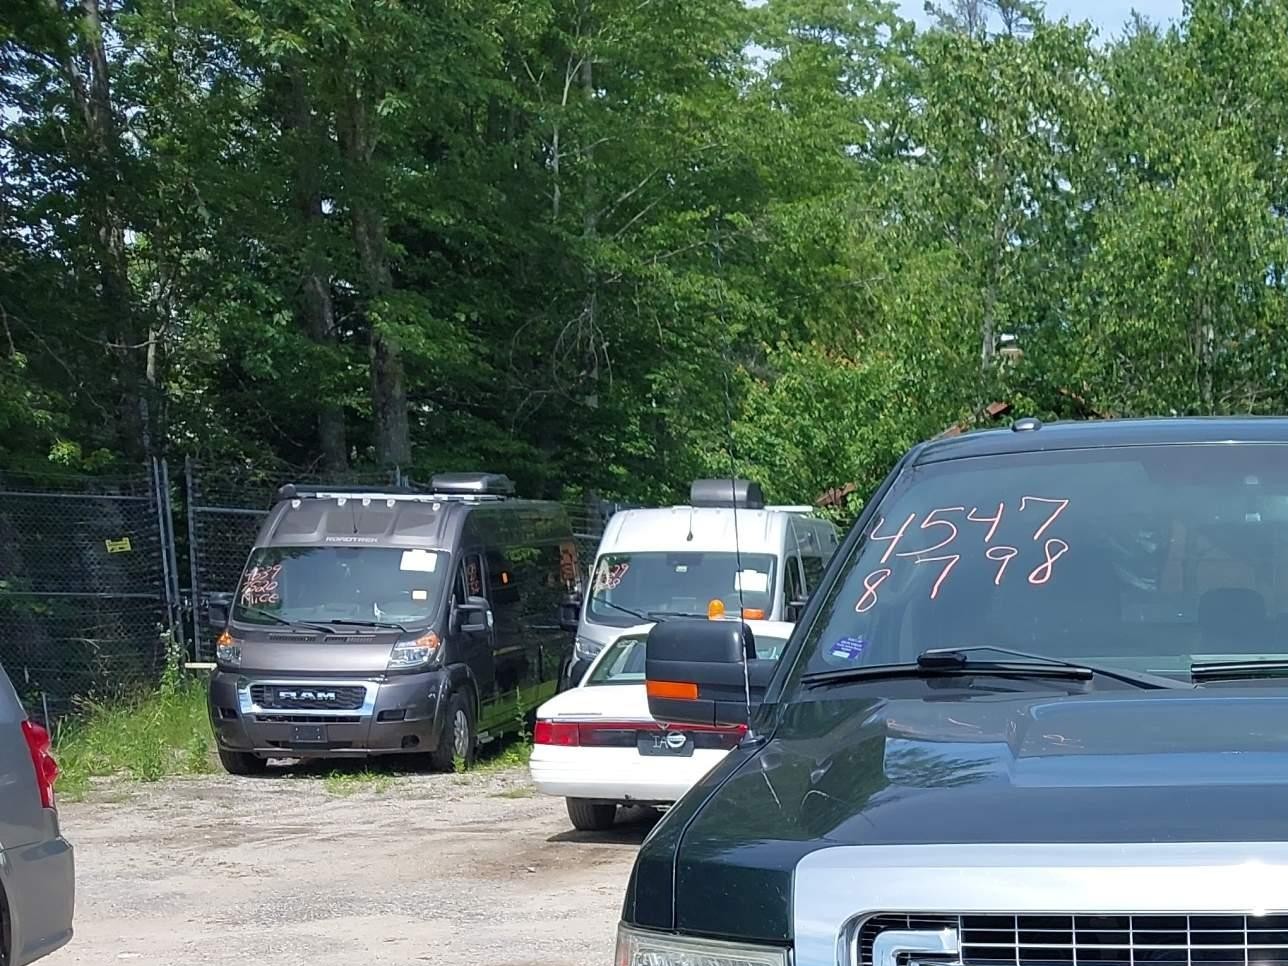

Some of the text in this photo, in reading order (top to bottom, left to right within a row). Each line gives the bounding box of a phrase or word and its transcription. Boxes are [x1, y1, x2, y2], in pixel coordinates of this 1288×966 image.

[870, 496, 1069, 564] 4547
[855, 539, 1069, 613] 8798
[279, 691, 336, 701] RAM
